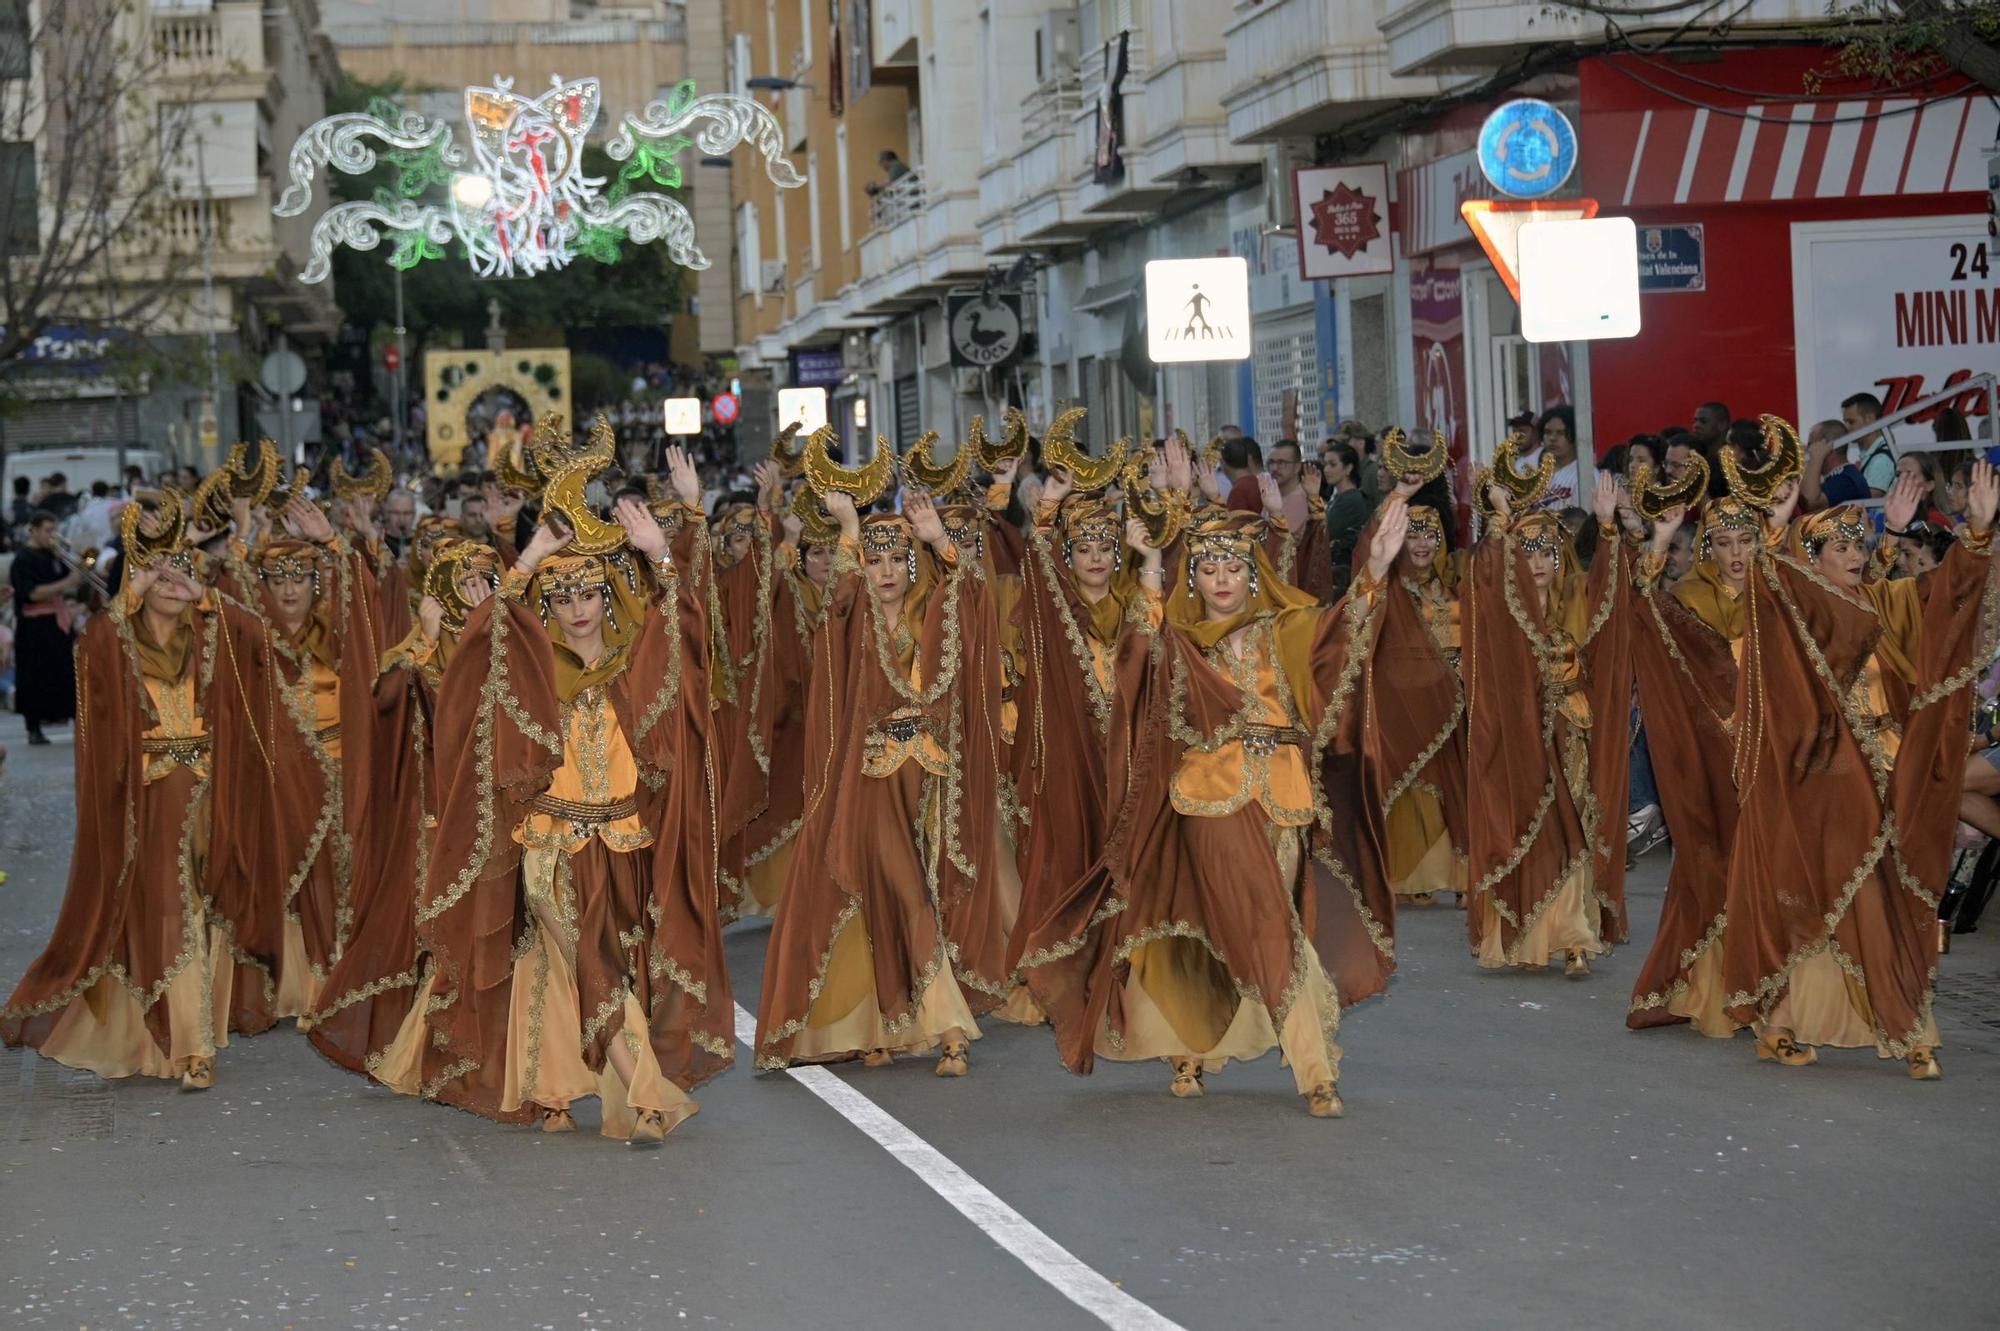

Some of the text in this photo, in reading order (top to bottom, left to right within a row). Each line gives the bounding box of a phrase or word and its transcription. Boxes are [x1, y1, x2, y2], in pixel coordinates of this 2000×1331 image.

[1657, 250, 1667, 260] de
[1668, 250, 1678, 260] la
[1950, 242, 1989, 280] 24
[1654, 261, 1698, 276] Valenciana
[1895, 290, 1968, 348] MINI
